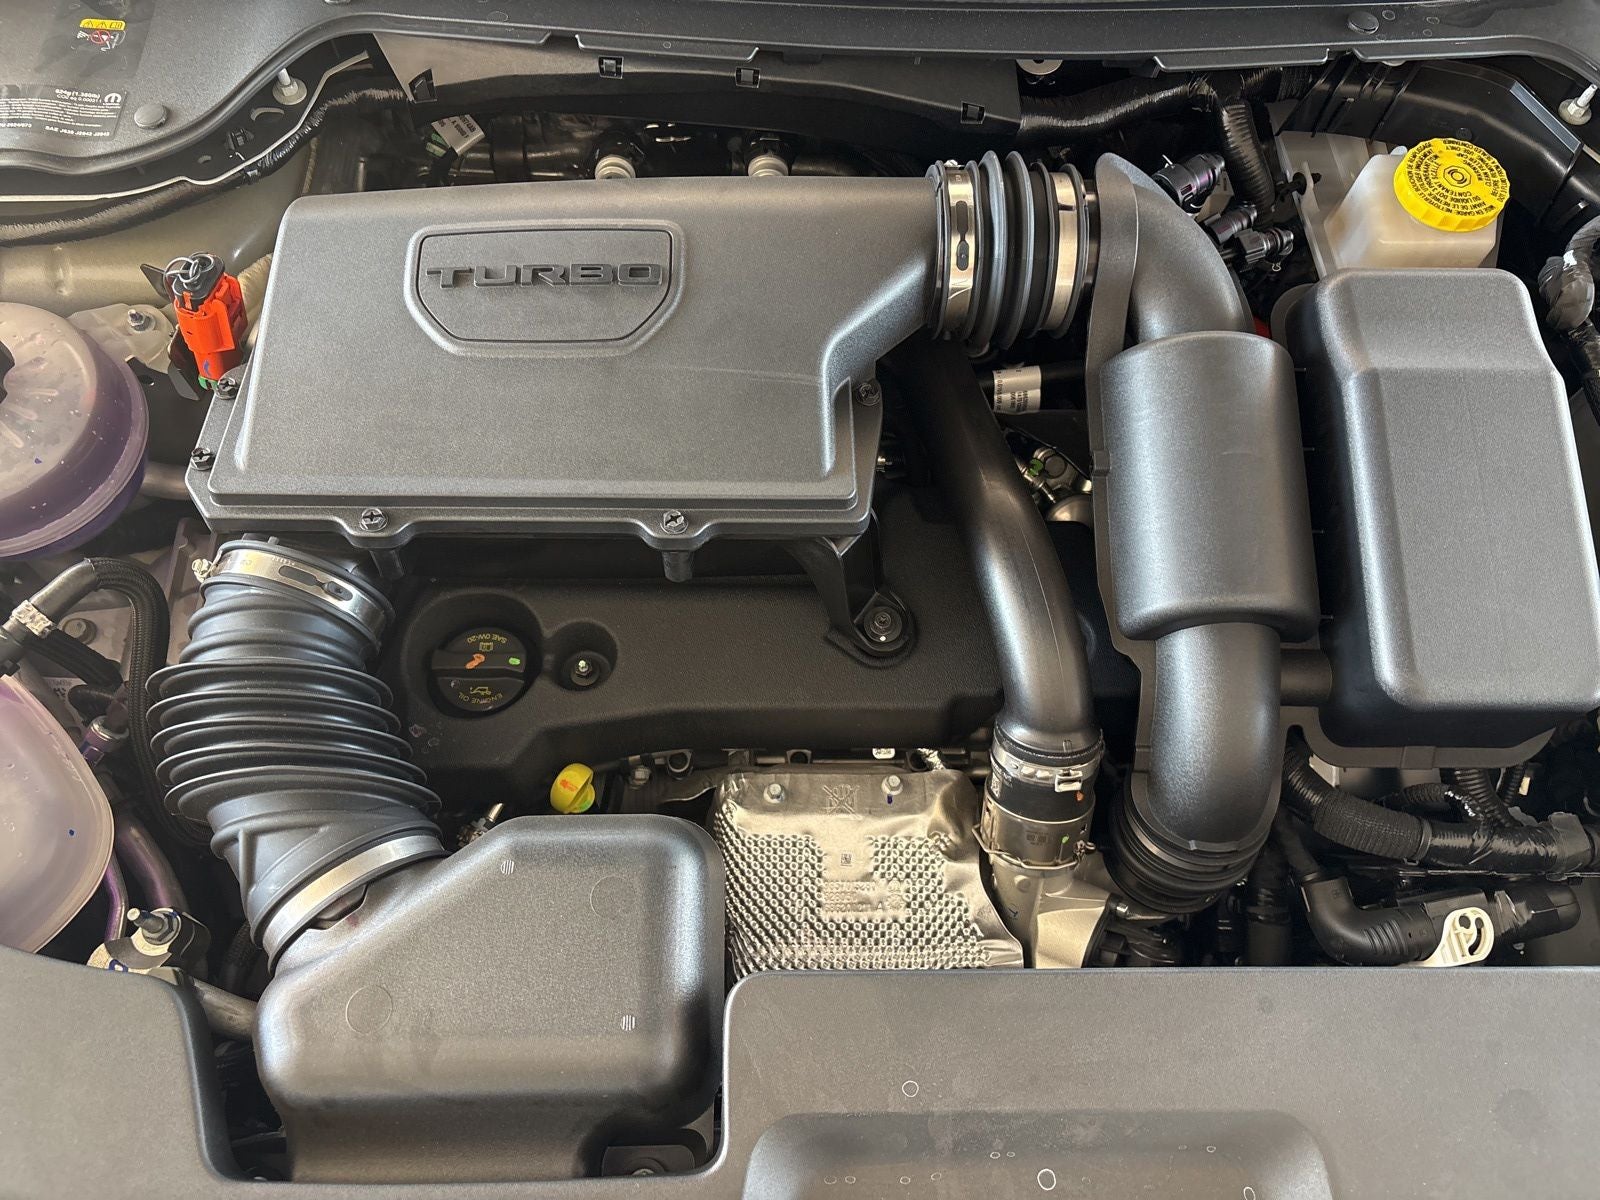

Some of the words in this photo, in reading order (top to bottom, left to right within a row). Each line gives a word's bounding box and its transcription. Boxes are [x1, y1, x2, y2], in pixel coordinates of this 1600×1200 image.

[1435, 190, 1448, 200] DOT
[426, 263, 663, 288] TURBO
[467, 633, 491, 644] 0W-20
[492, 633, 508, 644] SAE
[458, 691, 470, 702] OIL
[471, 692, 503, 704] ENGINE
